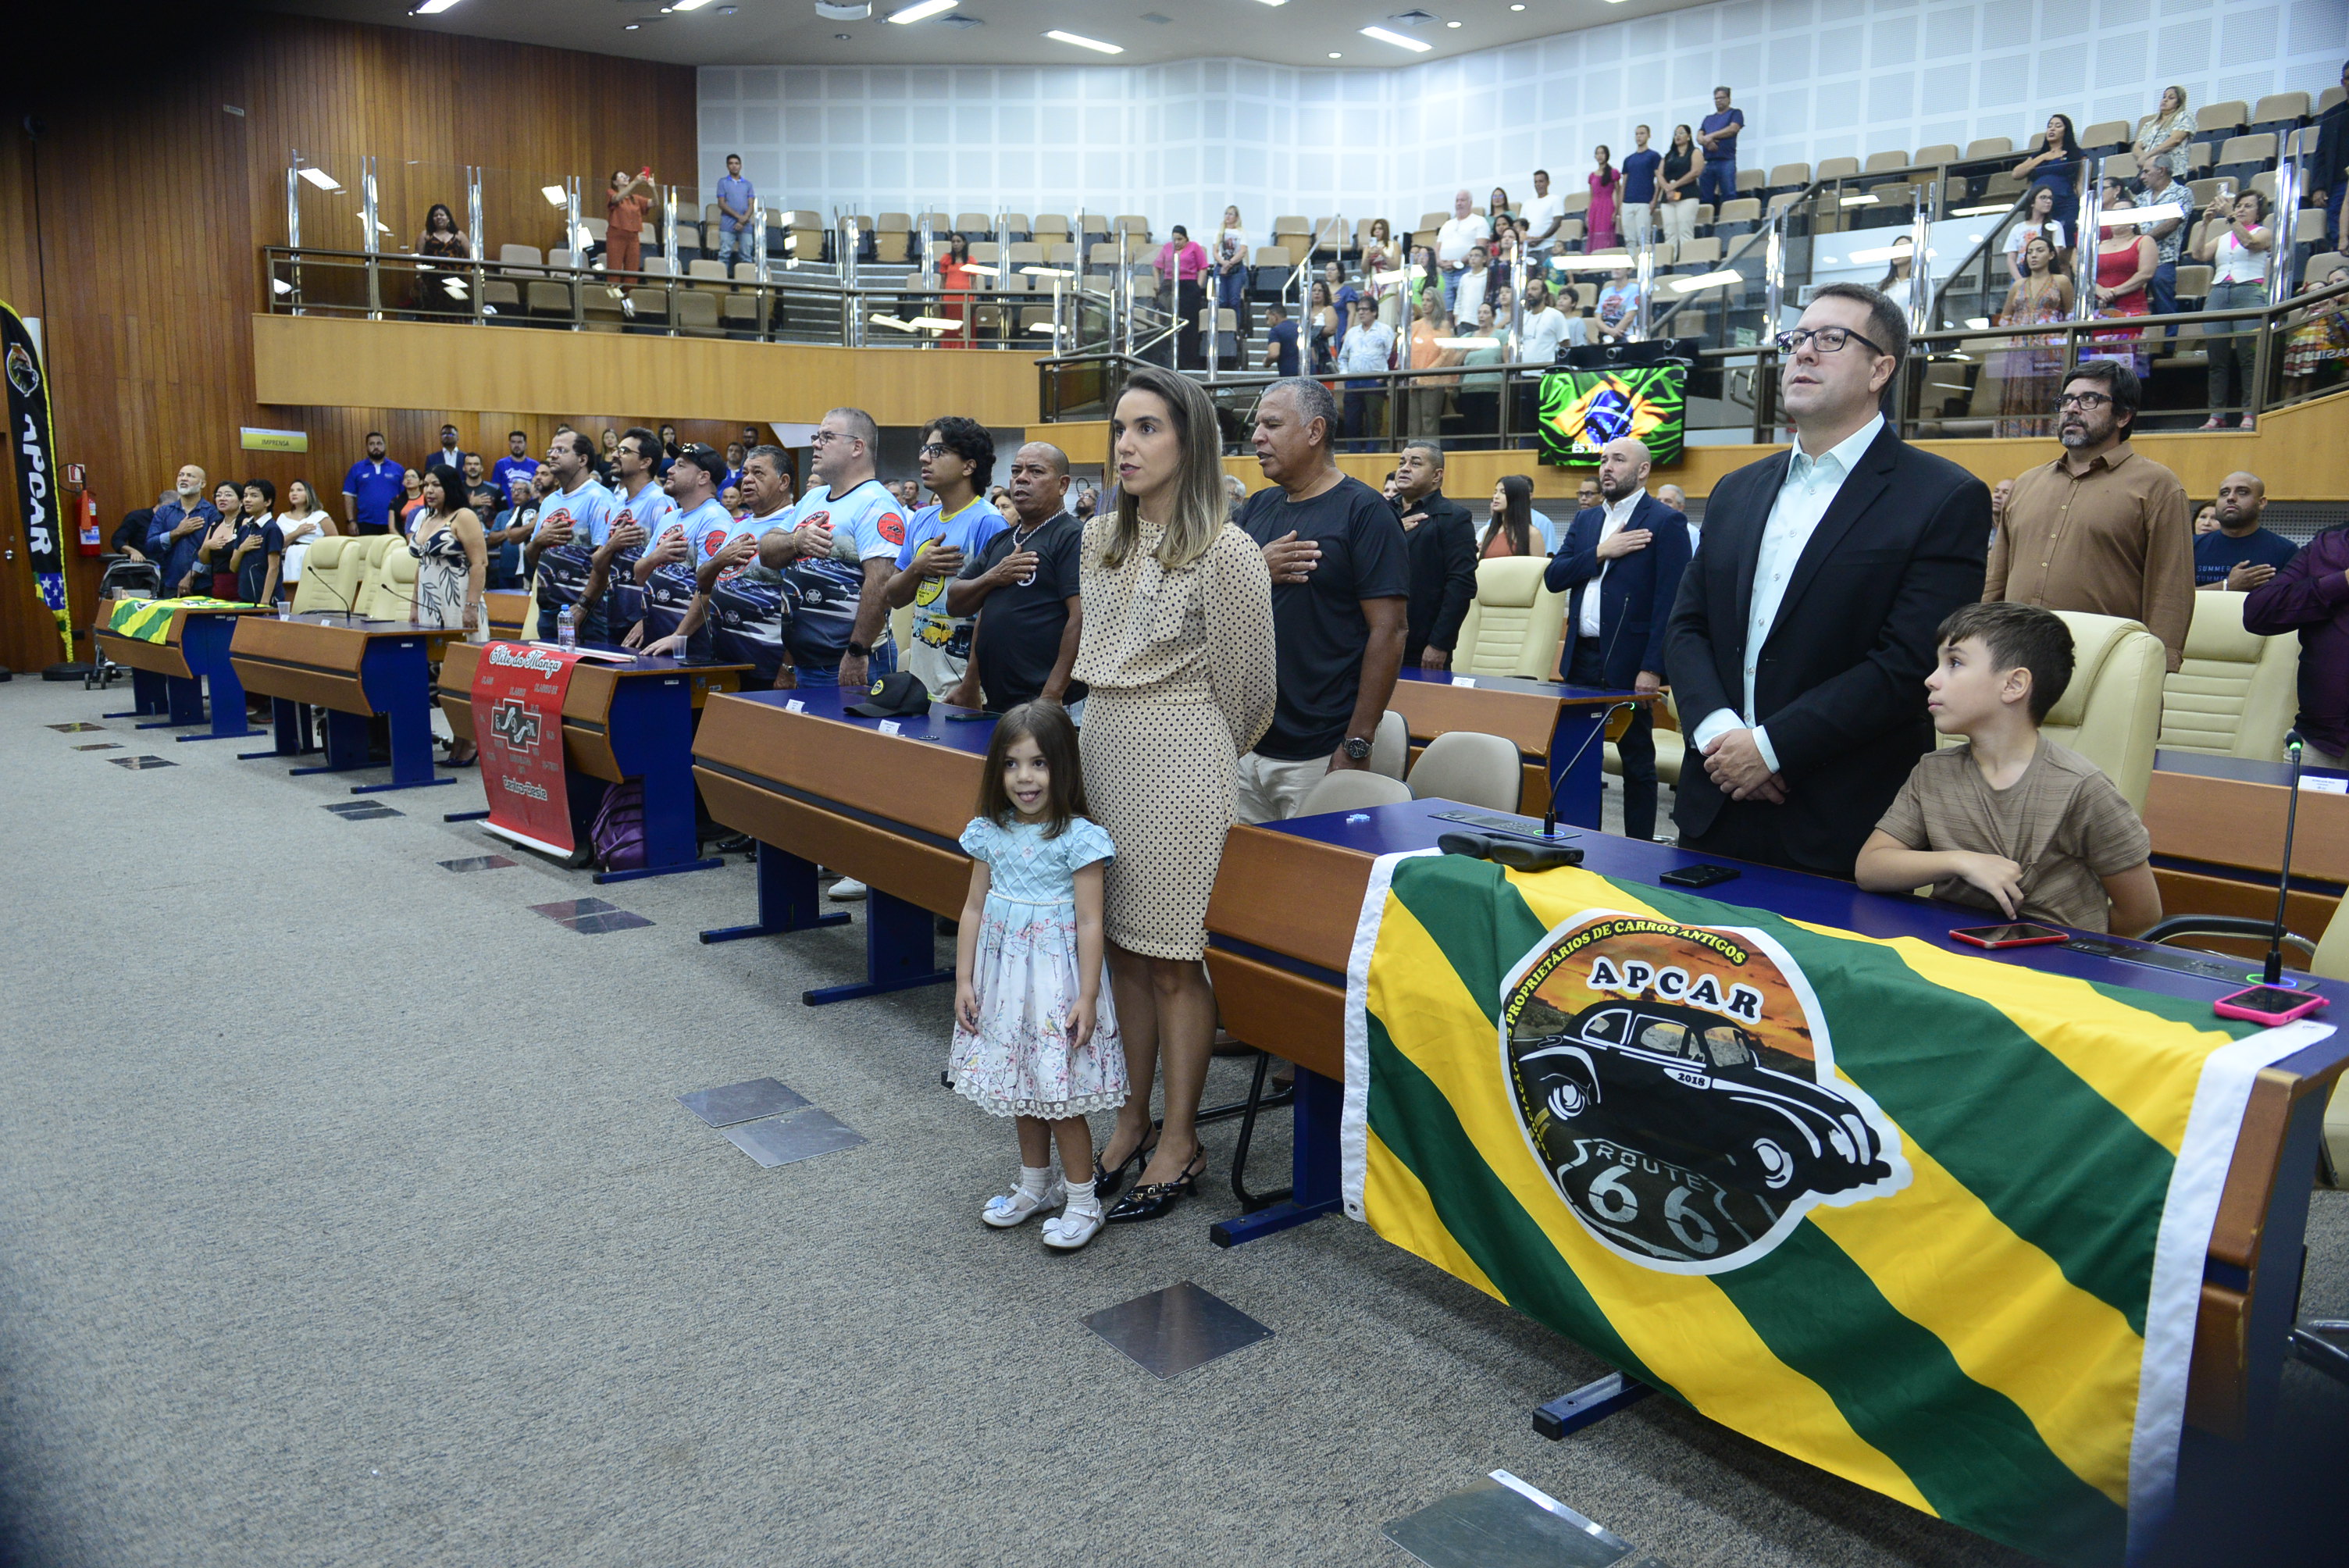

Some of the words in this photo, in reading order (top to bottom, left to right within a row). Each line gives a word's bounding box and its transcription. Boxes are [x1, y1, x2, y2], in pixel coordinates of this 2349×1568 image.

[1572, 440, 1585, 453] ÉS
[1587, 443, 1601, 453] TU
[23, 413, 52, 554] APCAR
[490, 644, 513, 666] Elite
[525, 650, 562, 679] Monza
[1506, 933, 1591, 1025] PROPRIETÁRIOS
[1592, 924, 1612, 940] DE
[1614, 921, 1679, 934] CARROS
[1677, 927, 1747, 964] ANTIGOS
[1590, 961, 1759, 1020] APCAR
[1677, 1072, 1706, 1086] 2018
[1595, 1144, 1705, 1192] ROUTE
